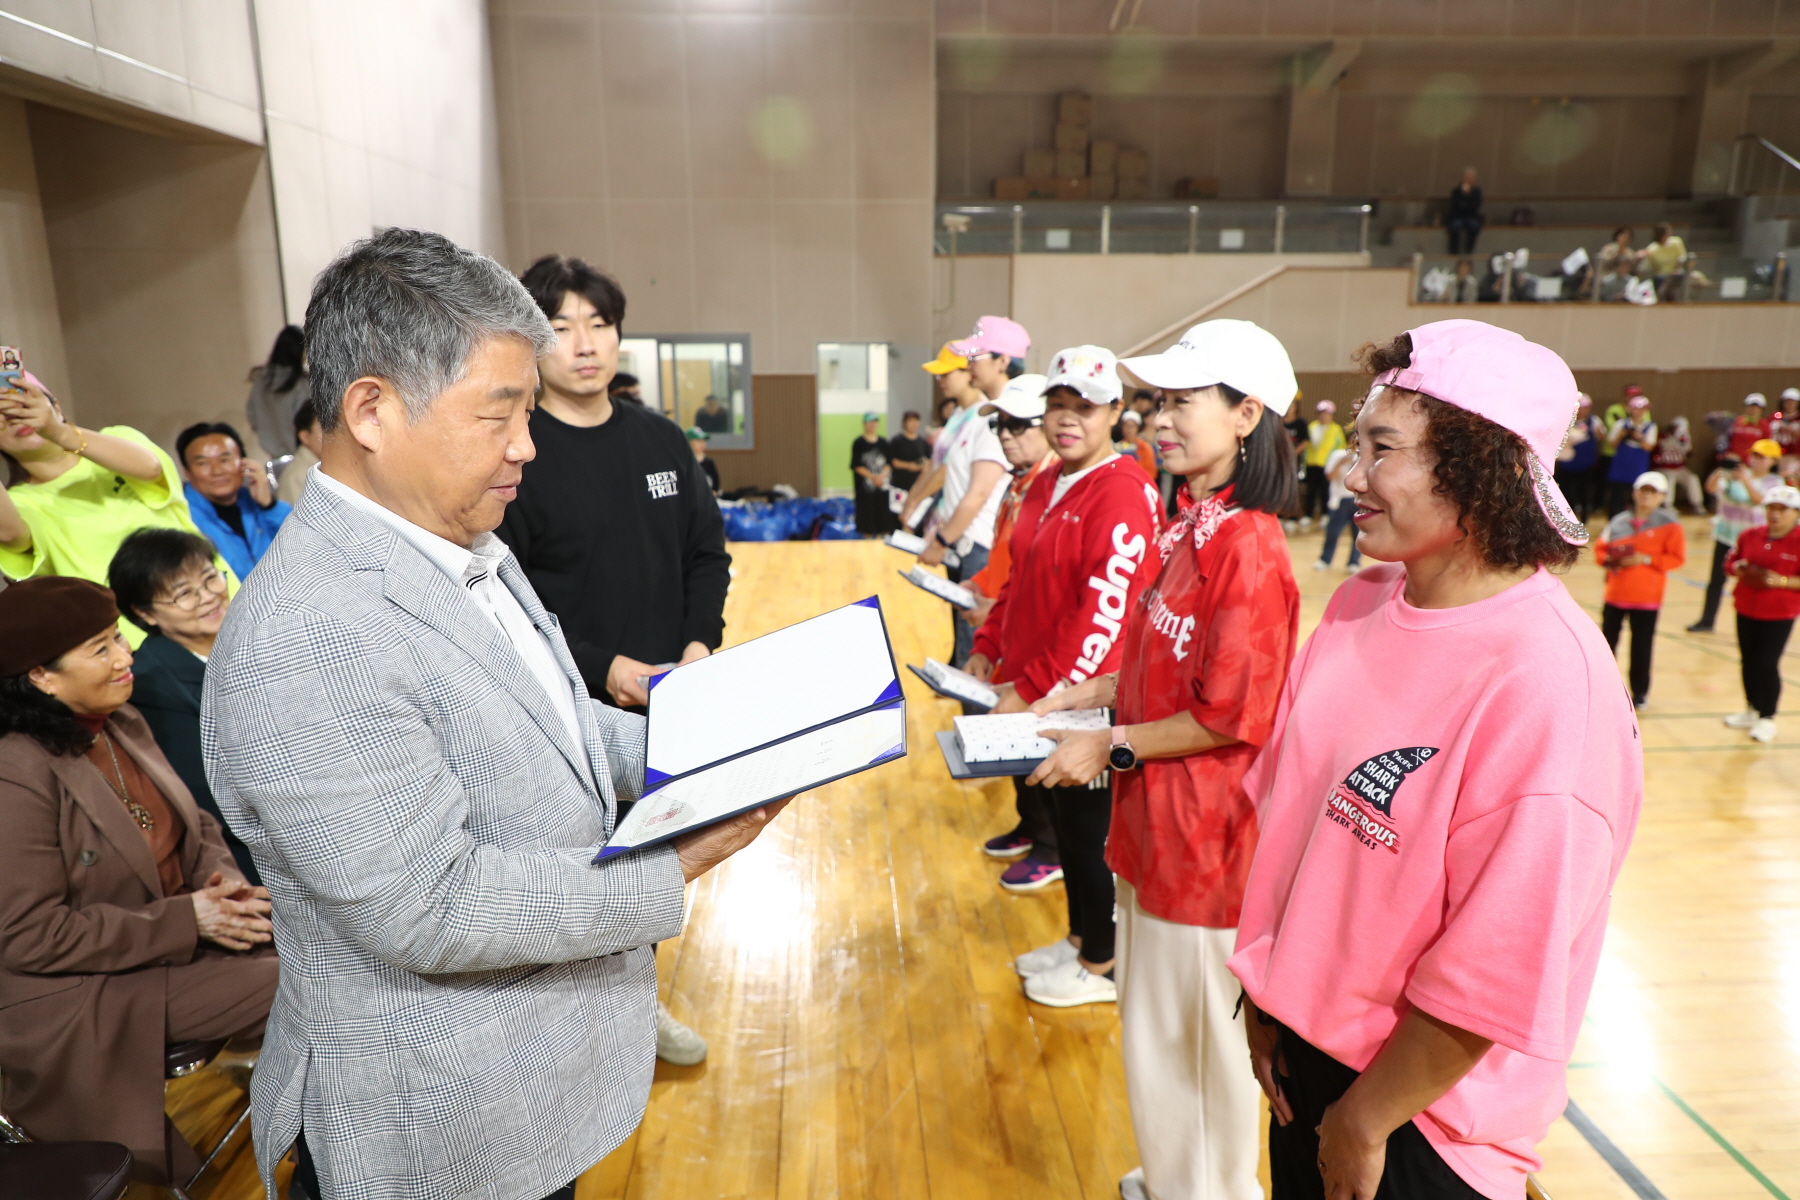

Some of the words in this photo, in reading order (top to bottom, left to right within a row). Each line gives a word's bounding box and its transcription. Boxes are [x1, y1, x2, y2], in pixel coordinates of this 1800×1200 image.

[645, 470, 678, 487] BEEN
[647, 482, 679, 499] TRILL
[1378, 755, 1403, 776] OCEAN
[1392, 750, 1414, 770] PACIFIC
[1363, 760, 1400, 790] SHARK
[1348, 770, 1391, 805] ATTACK
[1325, 808, 1352, 829] SHARK
[1351, 827, 1378, 851] AREAS
